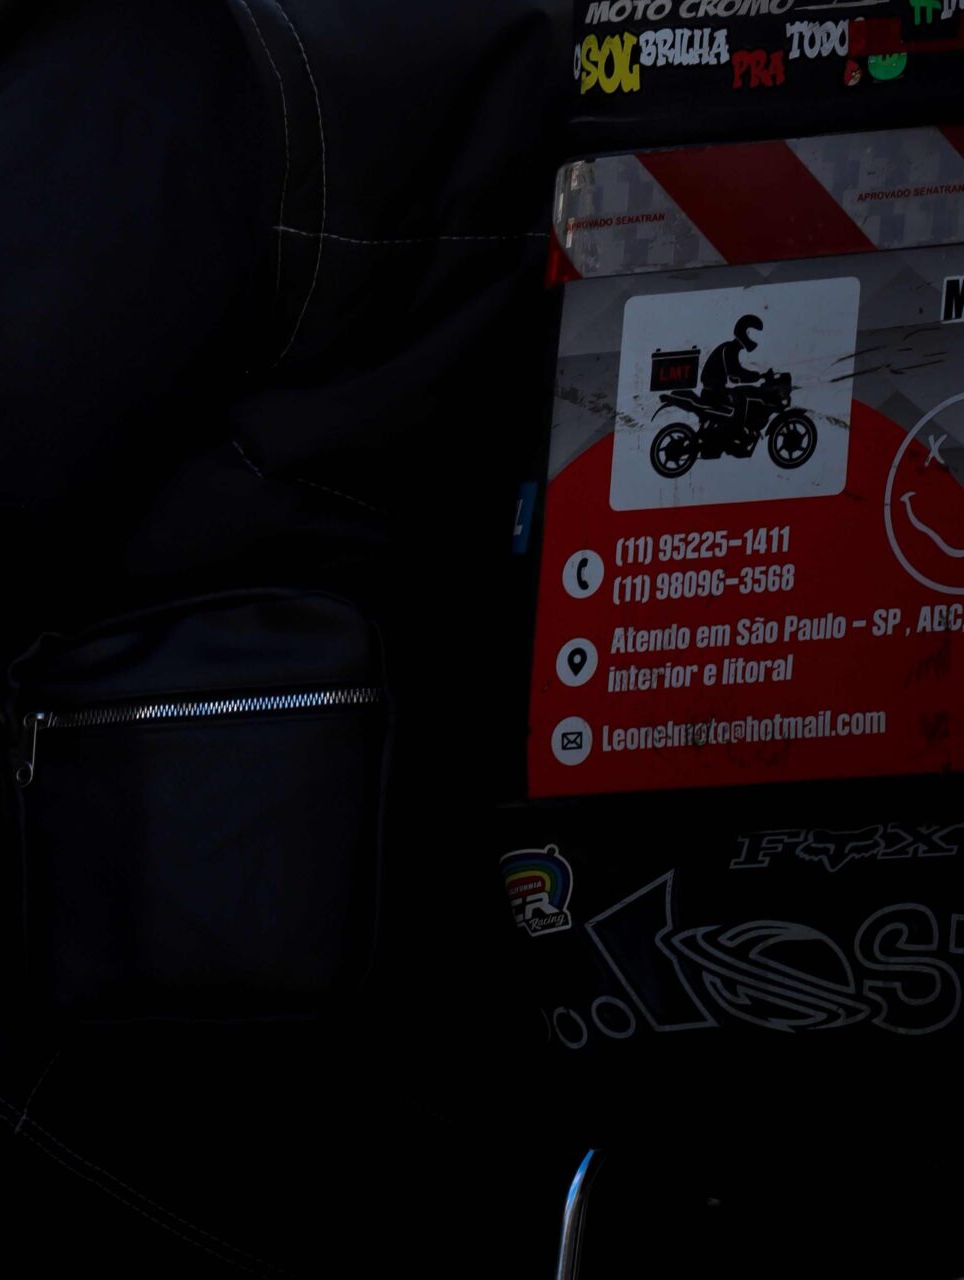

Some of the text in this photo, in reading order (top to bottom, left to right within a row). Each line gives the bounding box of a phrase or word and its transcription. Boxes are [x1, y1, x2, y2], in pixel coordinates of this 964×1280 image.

[581, 33, 640, 95] SOL
[639, 28, 730, 67] BRILHA
[730, 47, 787, 91] PRA
[786, 17, 865, 60] TODO
[857, 183, 964, 201] APROVADO SENATRAN
[615, 212, 666, 226] SENATRAN
[615, 525, 791, 568] (11) 95225-1411
[613, 563, 796, 606] (11) 98096-3568
[610, 623, 691, 655] Atendo
[696, 623, 731, 649] em
[736, 616, 779, 646] São
[783, 611, 847, 642] Paulo
[872, 607, 902, 637] SP
[607, 653, 794, 693] interior e litoral
